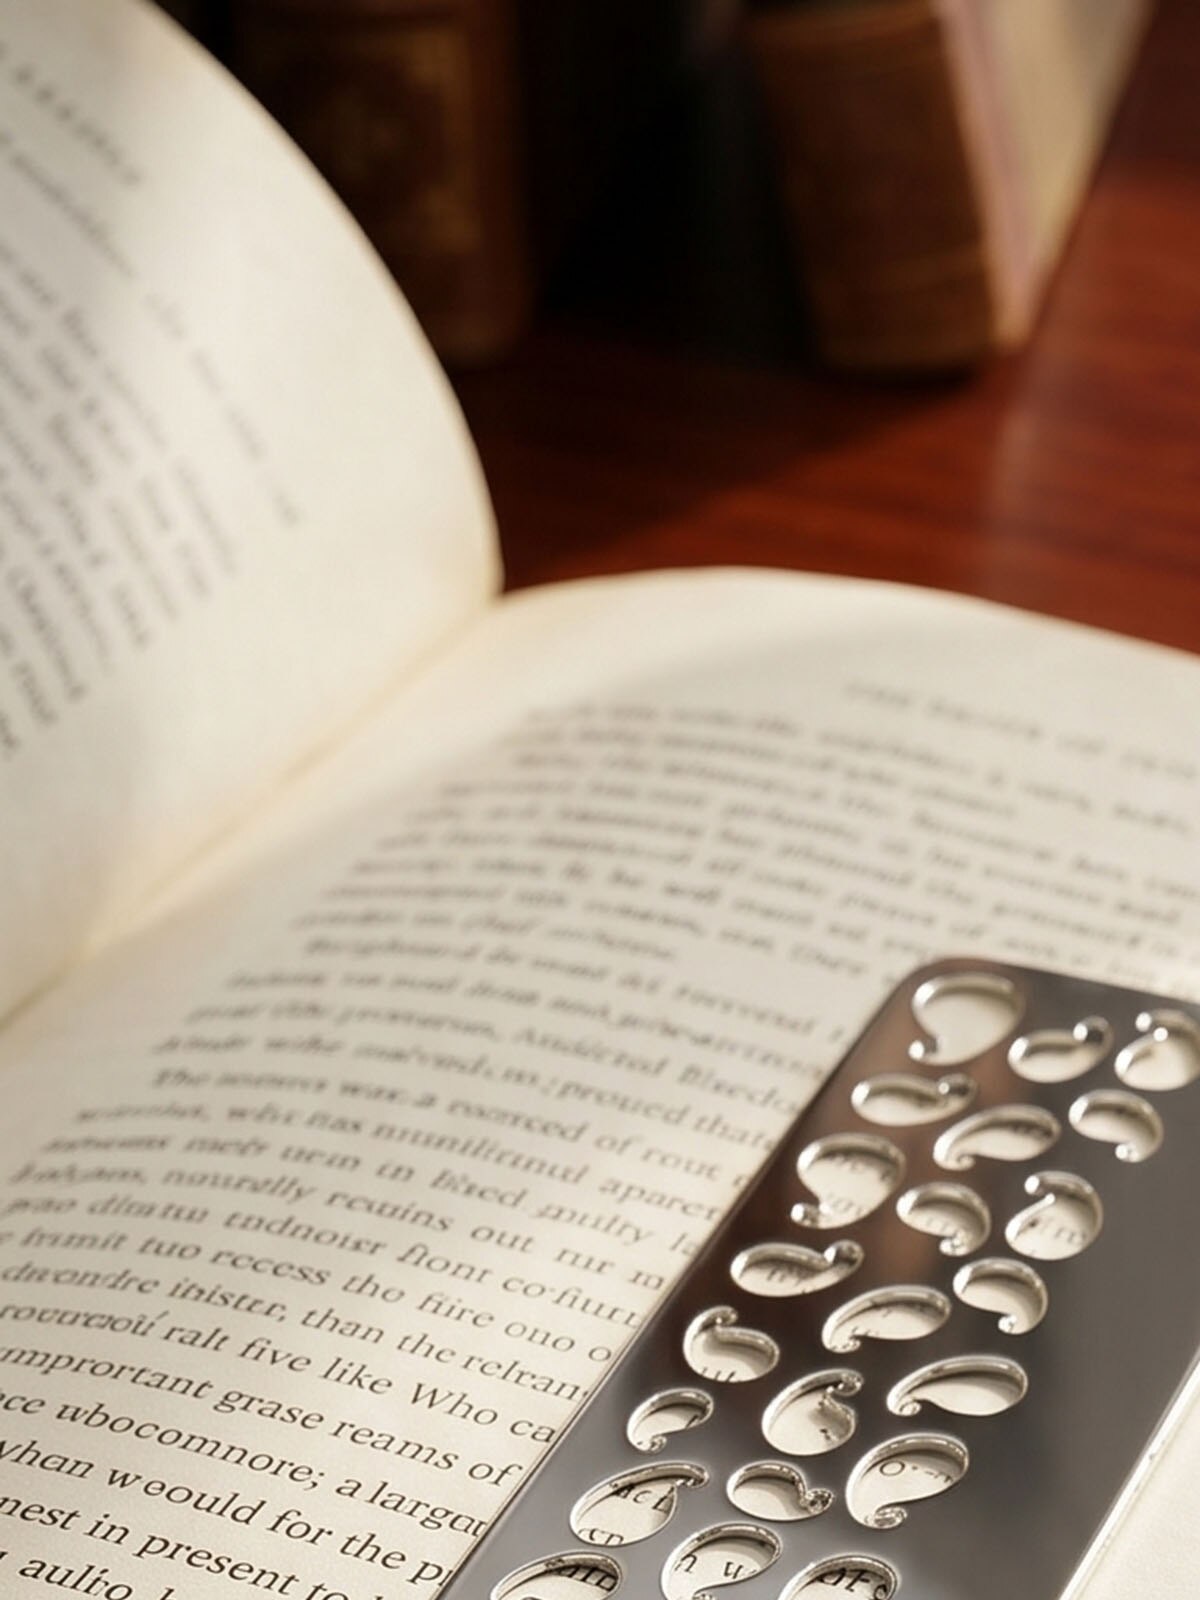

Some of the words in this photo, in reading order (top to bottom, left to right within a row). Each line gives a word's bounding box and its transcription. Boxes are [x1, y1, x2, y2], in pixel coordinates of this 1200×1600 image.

[300, 1307, 385, 1345] than
[238, 1336, 312, 1373] five
[318, 1356, 393, 1396] like
[410, 1381, 499, 1427] Who
[213, 1389, 325, 1431] grase
[328, 1419, 460, 1472] reams
[466, 1460, 524, 1488] of
[334, 1477, 363, 1500] a
[83, 1512, 131, 1546] in
[131, 1532, 302, 1597] present
[265, 1507, 335, 1547] for
[338, 1531, 407, 1572] the
